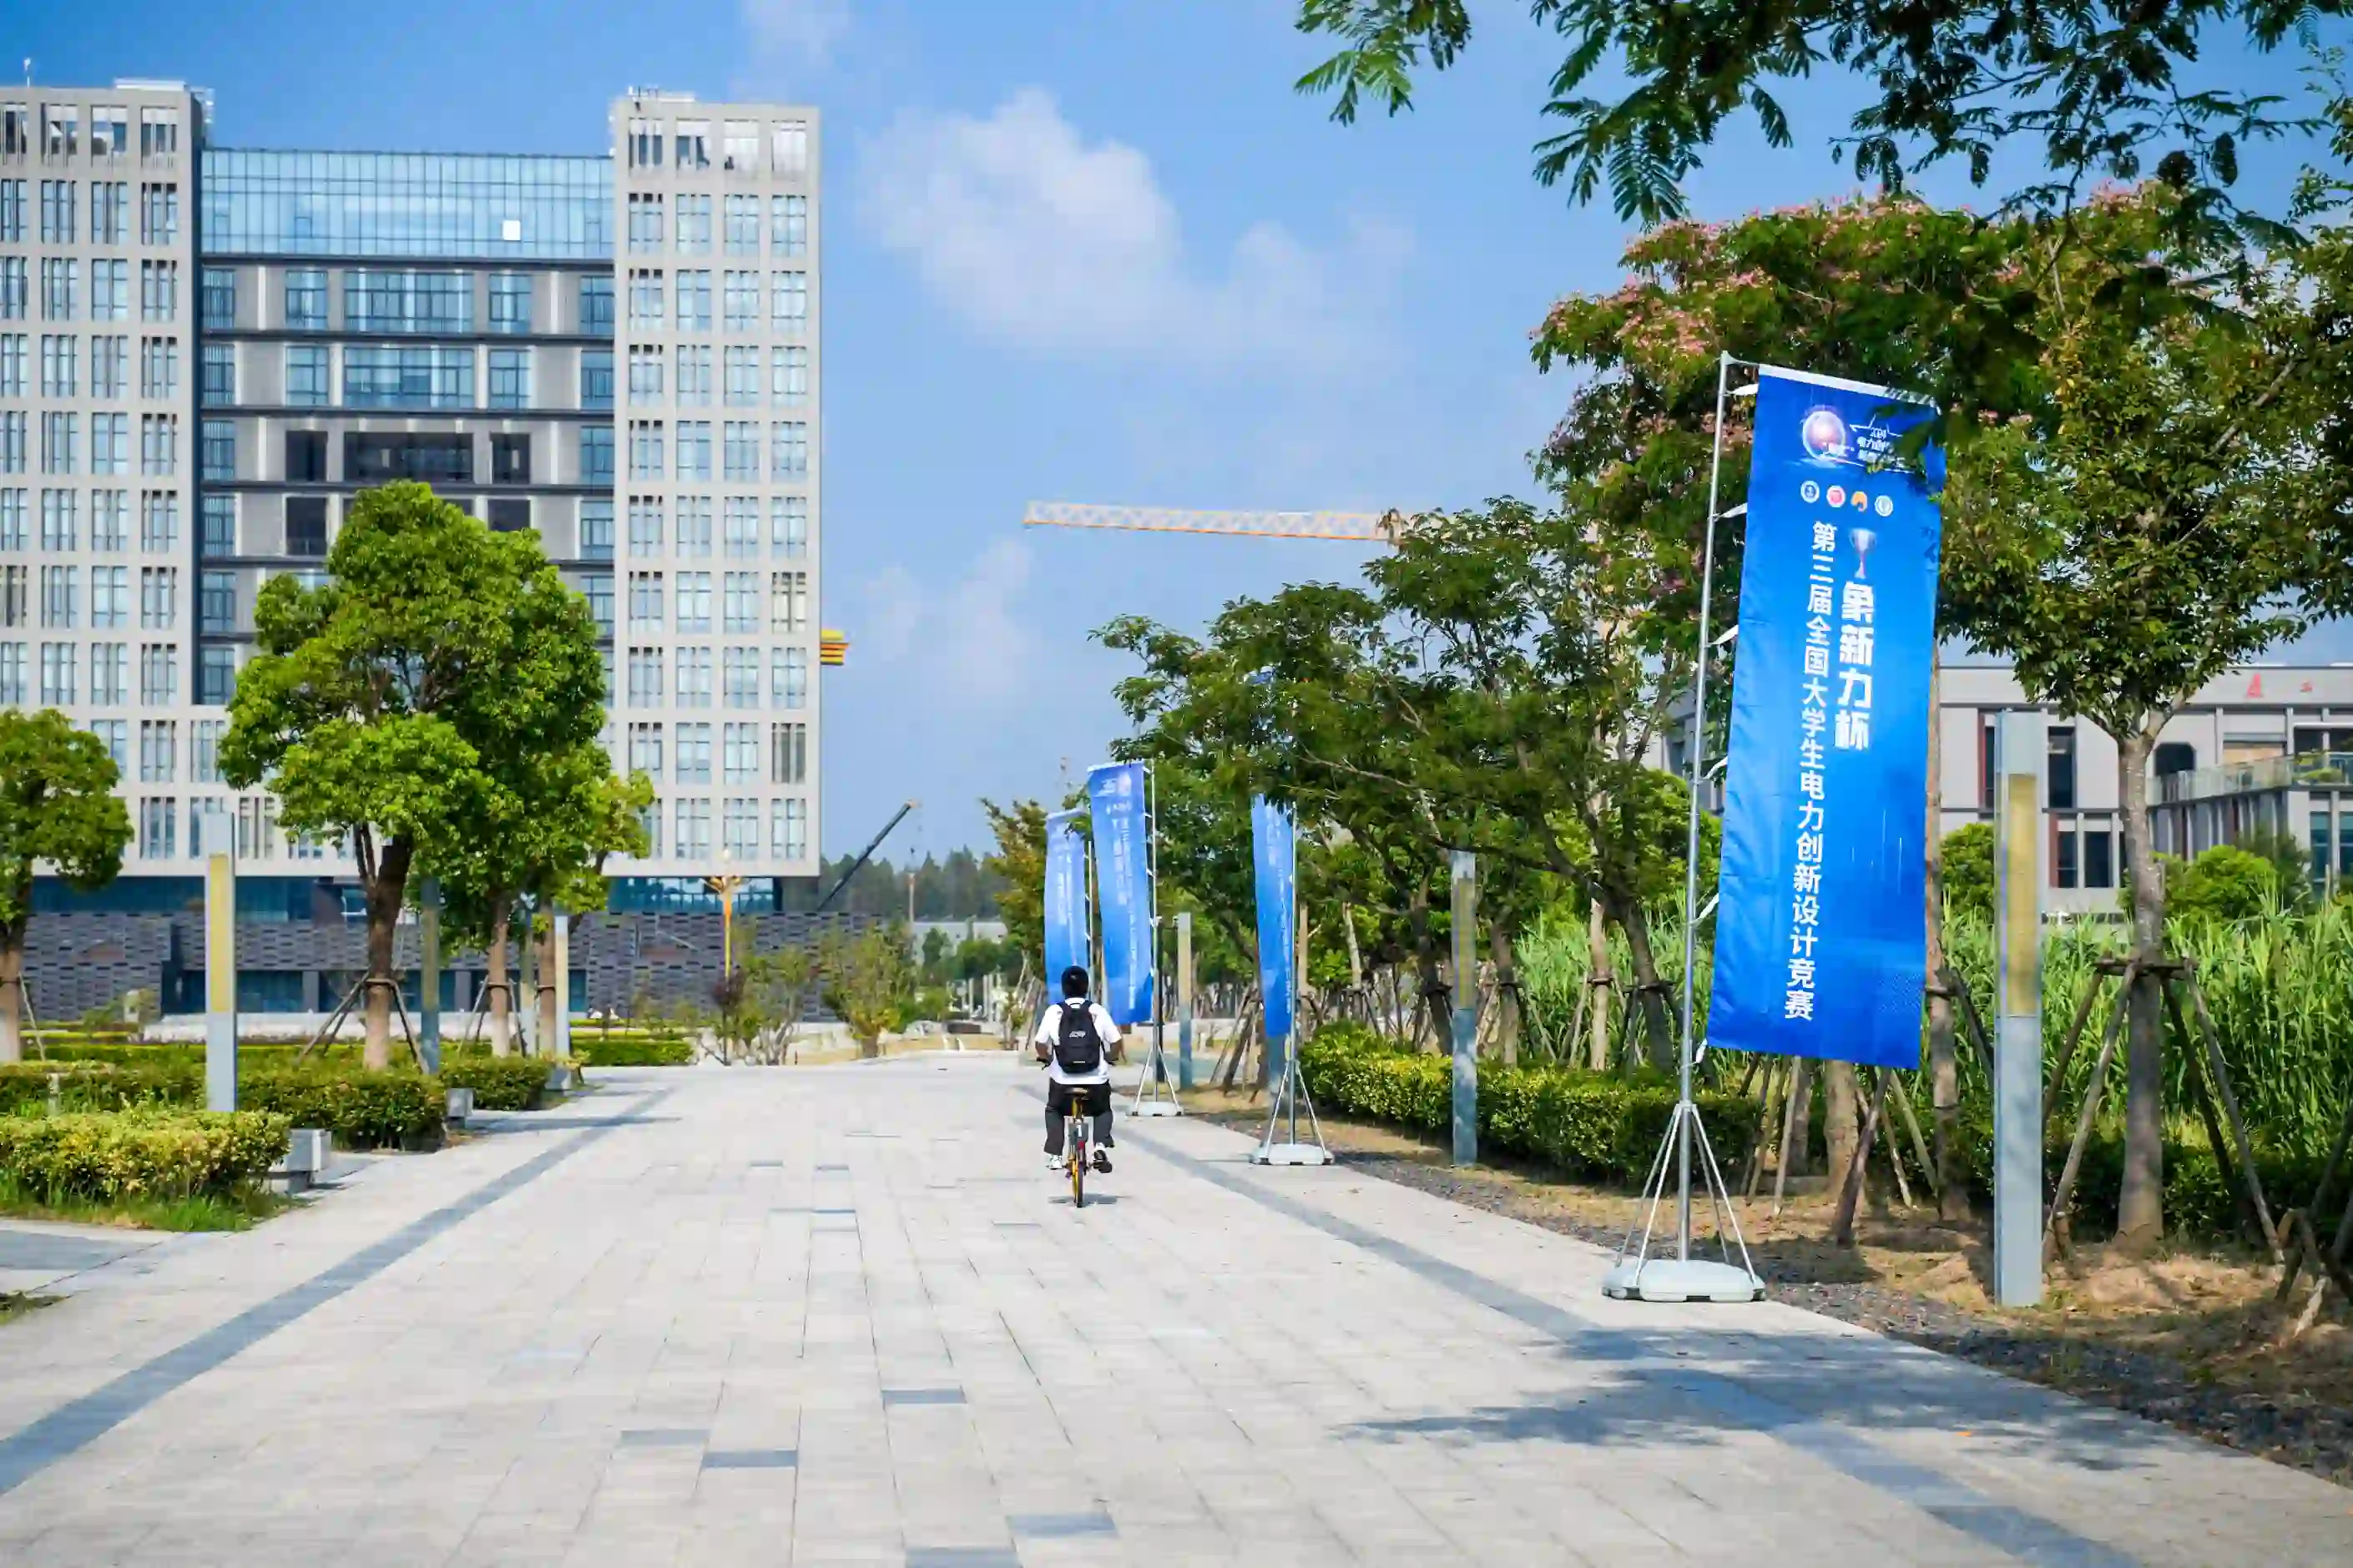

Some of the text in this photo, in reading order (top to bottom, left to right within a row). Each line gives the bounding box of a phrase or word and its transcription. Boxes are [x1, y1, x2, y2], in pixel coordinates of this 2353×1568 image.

[1785, 521, 1837, 1021] 第三届全国大学生电力创新设计竞赛
